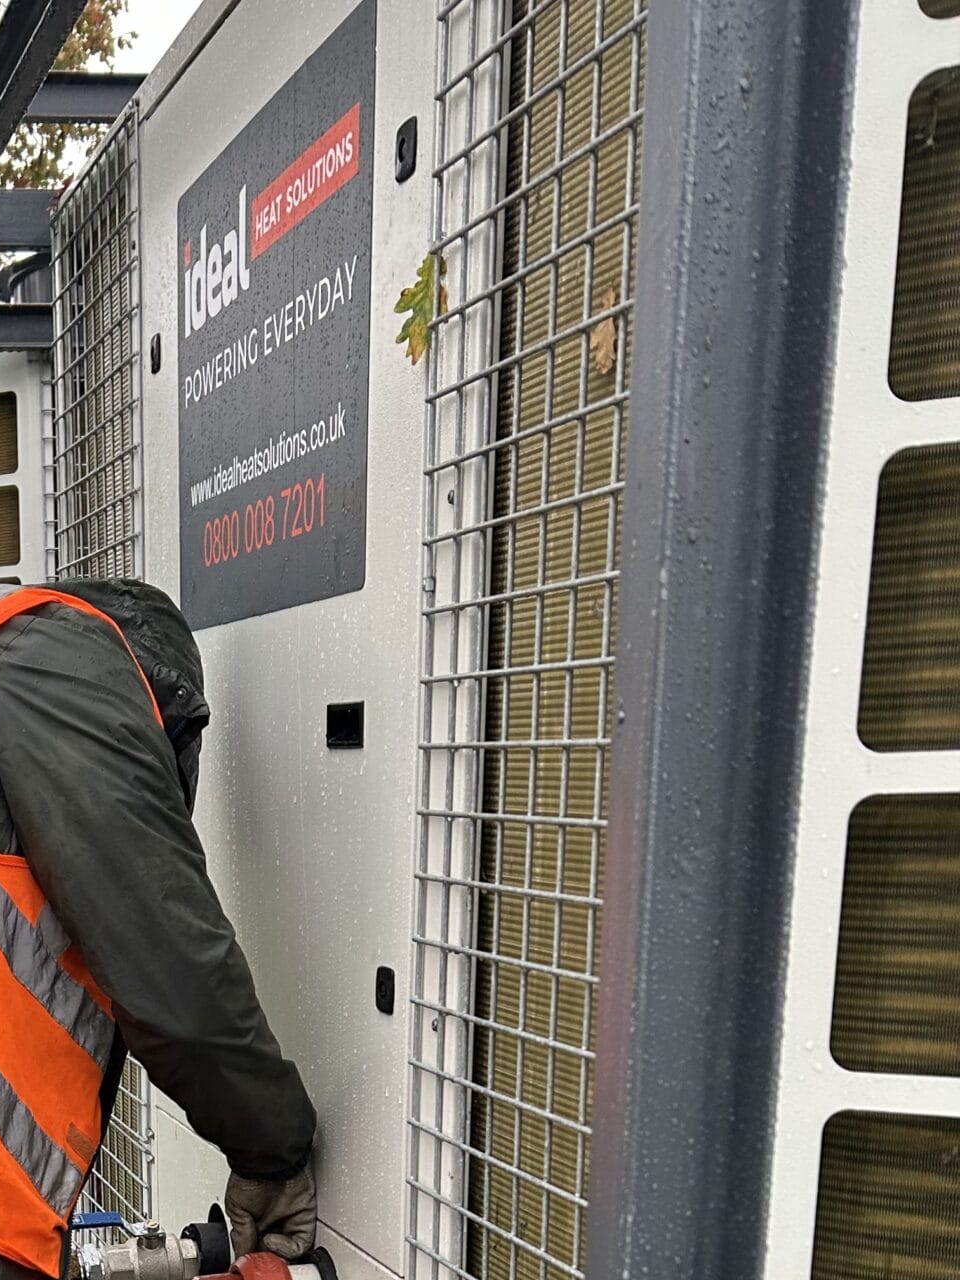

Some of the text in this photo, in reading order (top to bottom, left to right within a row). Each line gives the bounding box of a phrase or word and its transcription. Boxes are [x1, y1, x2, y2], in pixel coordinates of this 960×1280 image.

[255, 131, 353, 241] HEAT SOLUTIONS
[184, 184, 250, 338] ideal
[185, 255, 357, 408] POWERING EVERYDAY
[190, 402, 346, 507] www.idealheatsolutions.co.uk
[204, 472, 326, 567] 0800 008 7201
